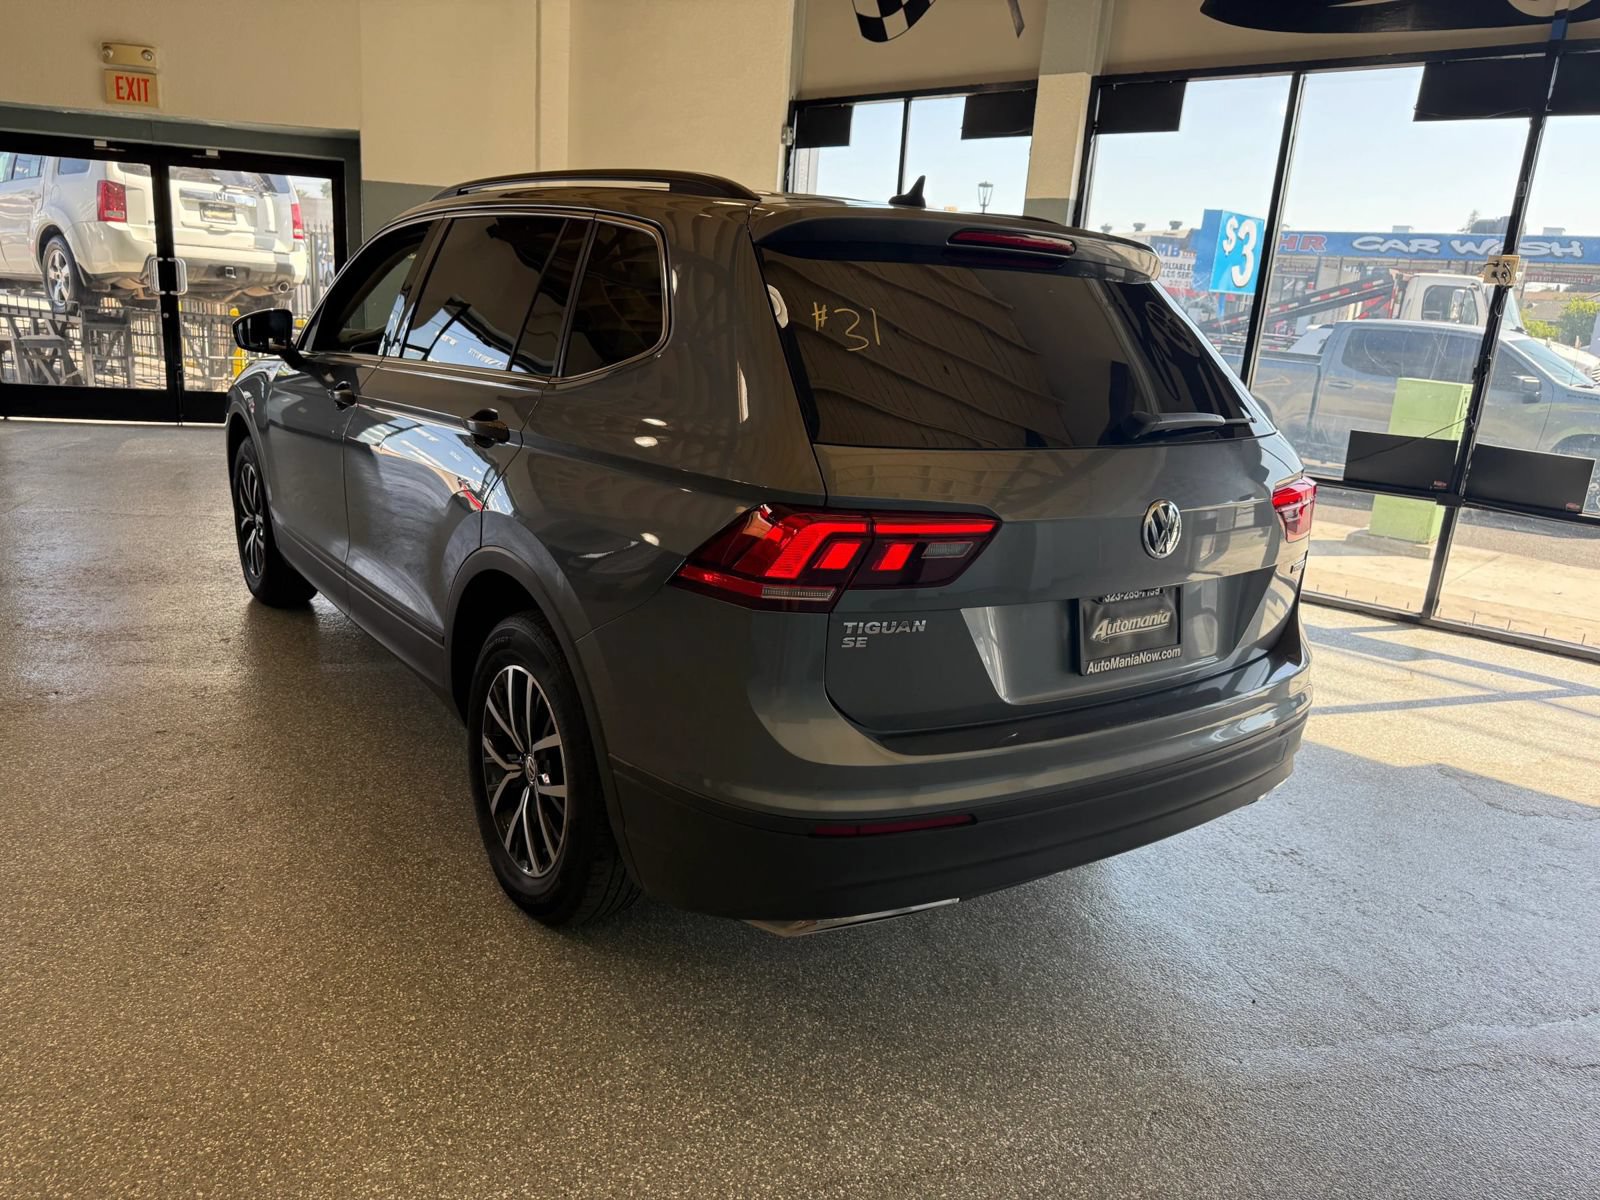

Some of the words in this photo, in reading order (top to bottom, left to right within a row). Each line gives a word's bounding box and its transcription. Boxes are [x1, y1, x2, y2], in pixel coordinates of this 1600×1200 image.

[115, 76, 150, 102] EXIT
[1222, 215, 1258, 288] $3
[1352, 236, 1441, 254] CAR
[811, 301, 880, 351] #31
[843, 620, 927, 634] TIGUAN
[1090, 609, 1171, 641] Automania
[841, 636, 868, 648] SE
[1086, 647, 1181, 675] AutoManiaNow.com
